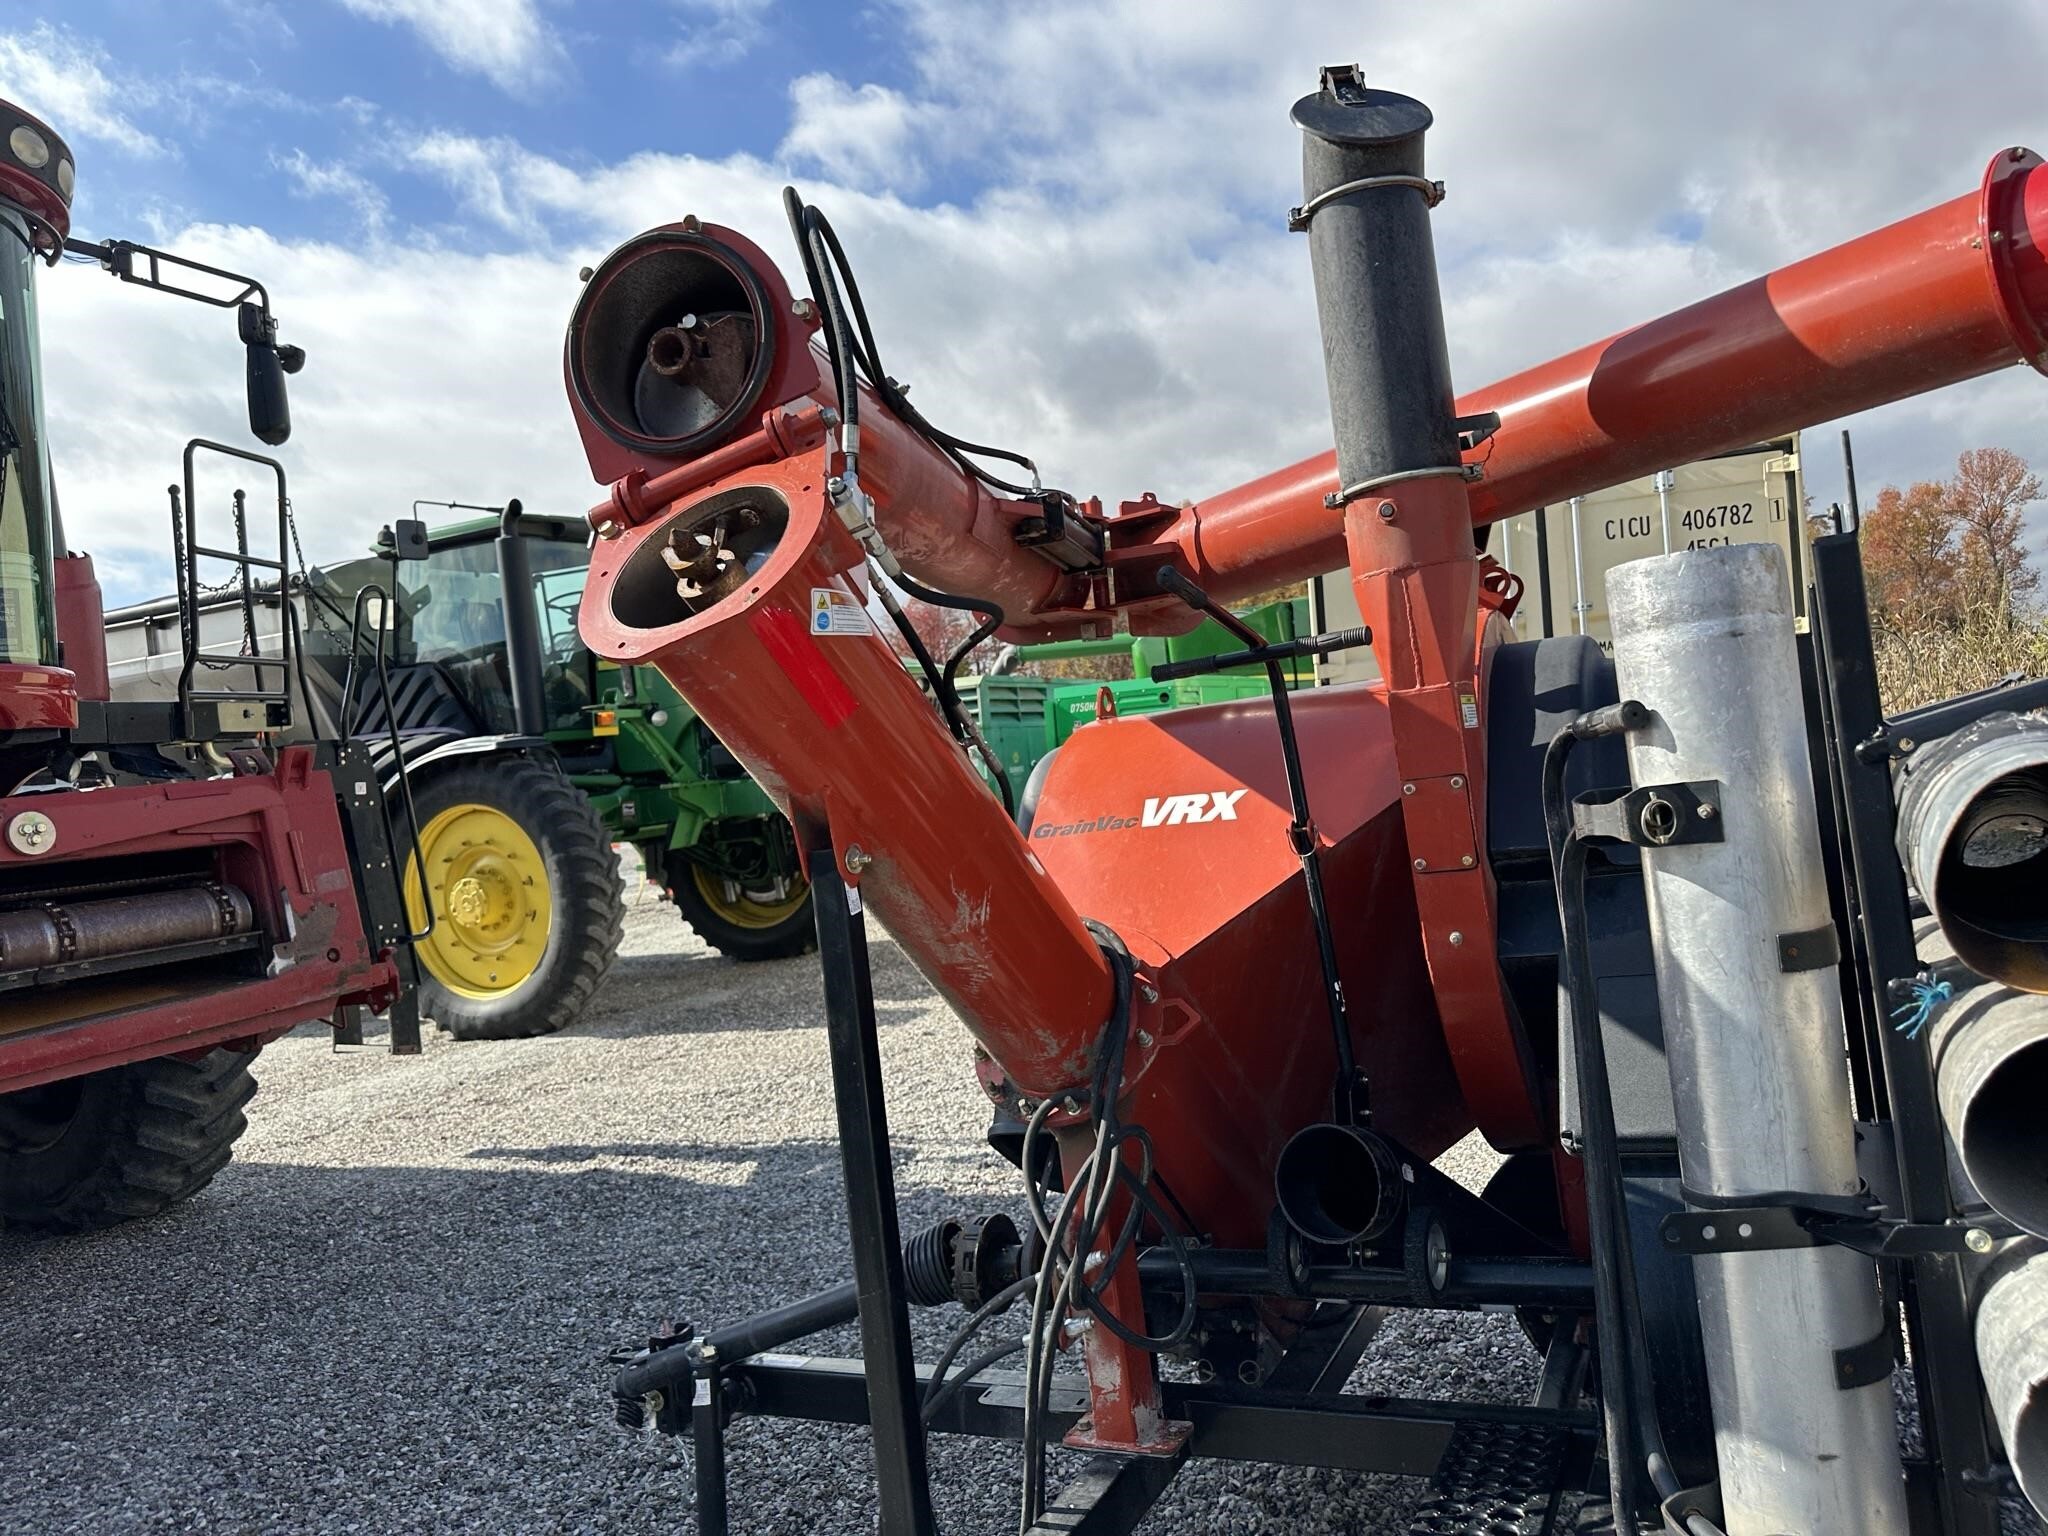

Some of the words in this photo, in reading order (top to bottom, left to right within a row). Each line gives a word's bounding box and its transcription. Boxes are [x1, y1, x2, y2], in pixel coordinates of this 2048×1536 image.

[1605, 515, 1651, 541] CICU
[1682, 503, 1753, 531] 406782
[1599, 640, 1614, 651] MA
[1070, 702, 1097, 714] D750H
[1034, 815, 1139, 839] GrainVac
[1141, 788, 1249, 828] VRX
